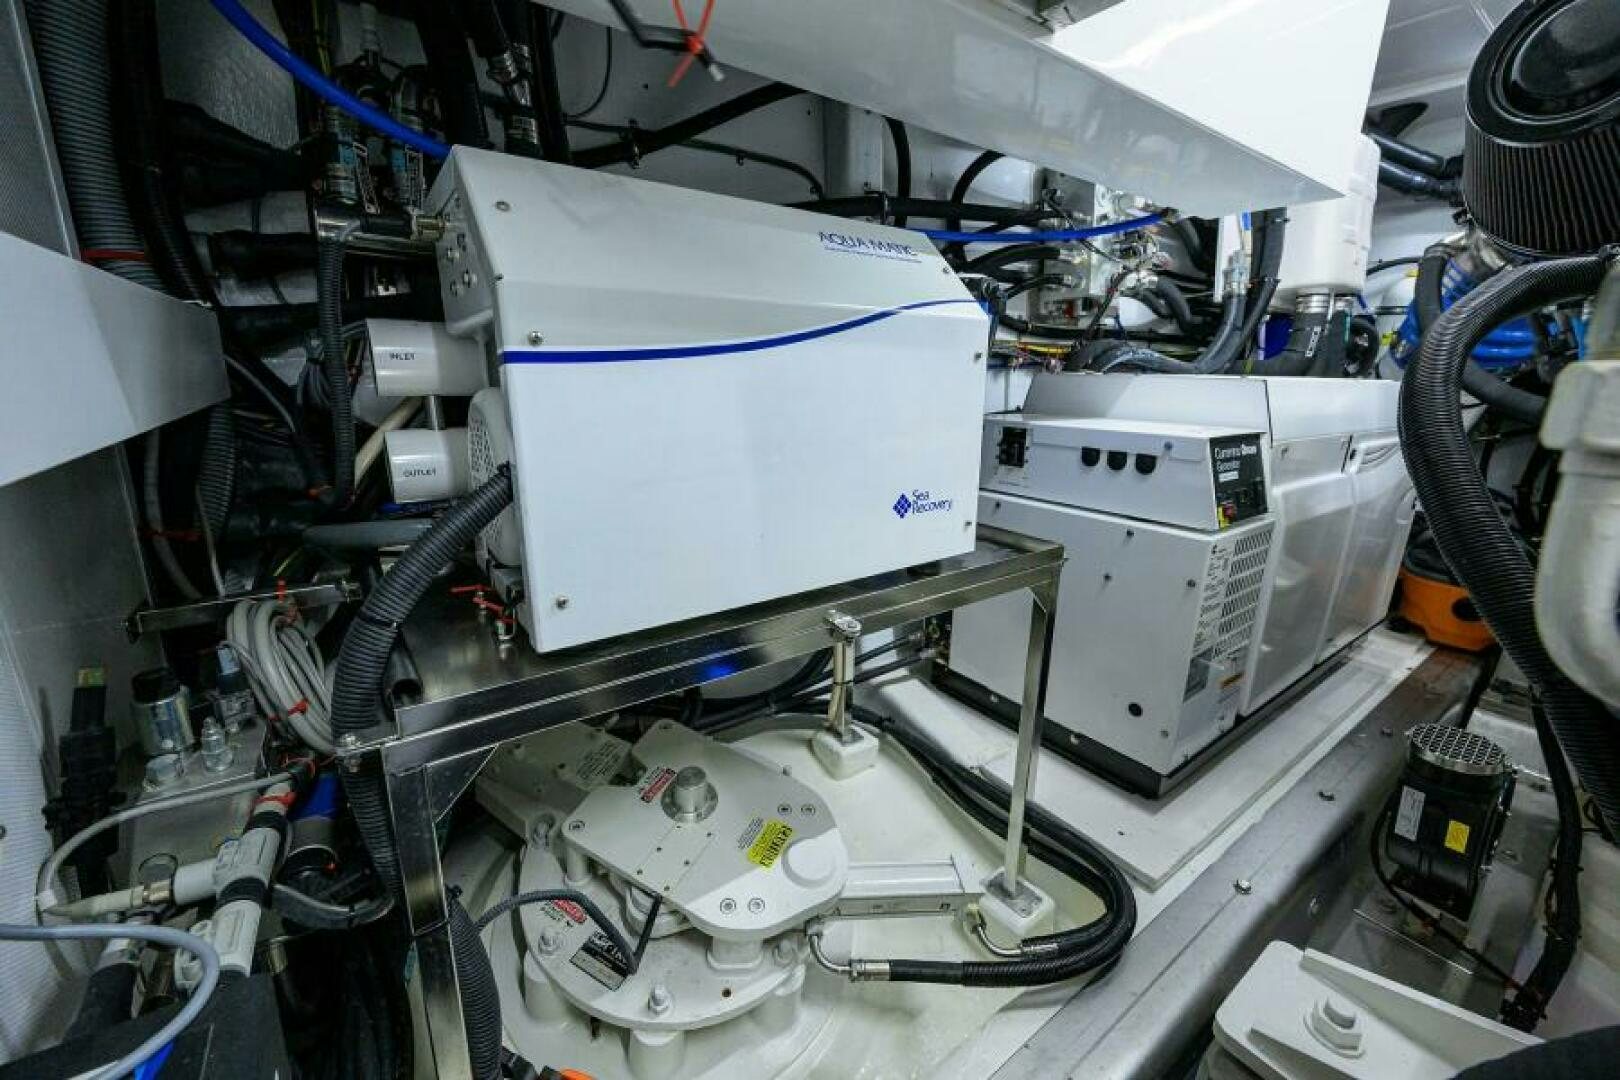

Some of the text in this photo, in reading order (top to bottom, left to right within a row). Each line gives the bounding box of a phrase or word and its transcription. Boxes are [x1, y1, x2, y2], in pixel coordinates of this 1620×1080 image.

[819, 231, 865, 248] AQUA
[868, 238, 918, 256] MATIC
[403, 468, 436, 476] OUTLET
[912, 489, 930, 501] Sea
[912, 499, 952, 514] Recovery
